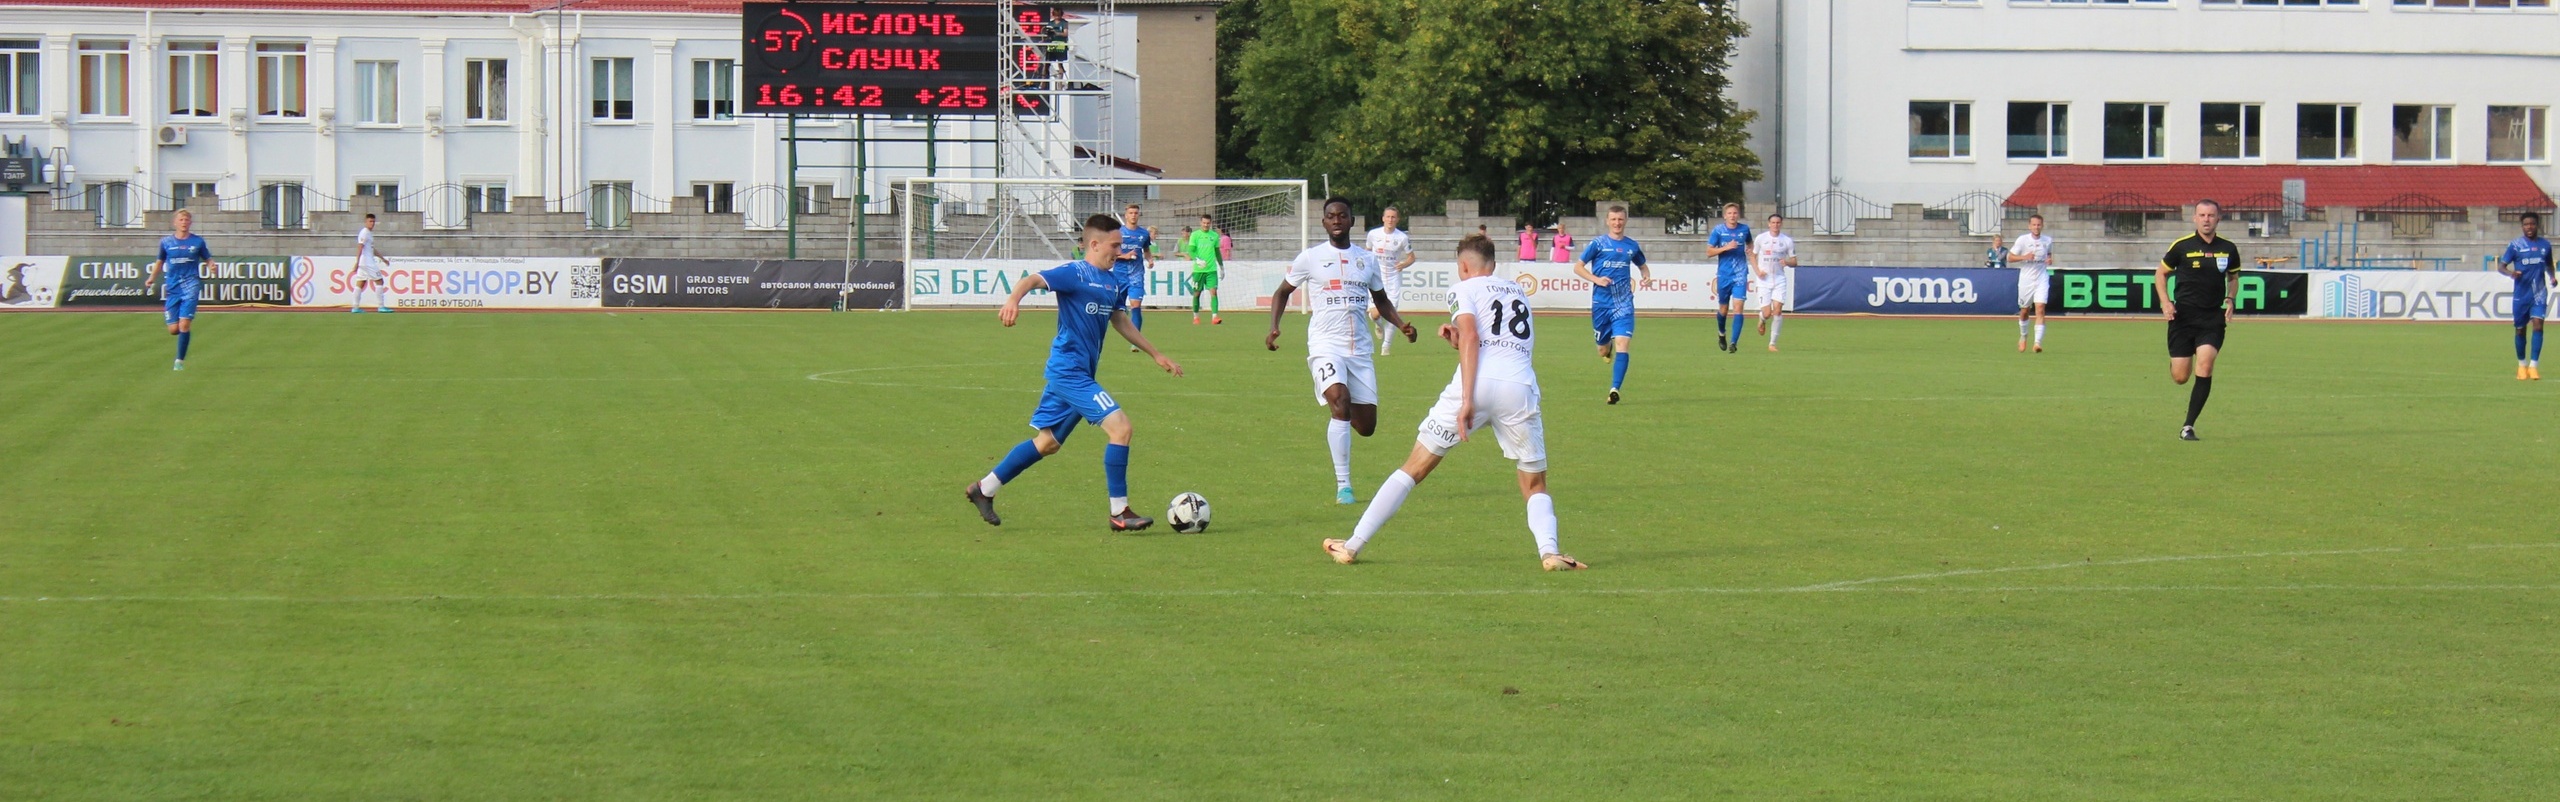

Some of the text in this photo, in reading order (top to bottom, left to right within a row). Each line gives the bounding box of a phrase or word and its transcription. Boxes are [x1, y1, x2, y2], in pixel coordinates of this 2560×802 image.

[821, 13, 965, 36] ИСЛОЧЬ
[765, 30, 803, 51] 57
[821, 48, 941, 70] СЛУЦК
[756, 84, 883, 107] 16:42
[79, 262, 139, 279] СТАНЬ
[686, 276, 750, 284] GRAD SEVEN
[219, 283, 285, 301] ИСЛОЧЬ
[613, 274, 667, 294] GSM
[686, 286, 729, 295] MOTORS
[760, 281, 896, 291] автосалон электромобилей
[2063, 274, 2266, 310] BETA
[398, 299, 484, 308] ВСЕ ДЛЯ ФУТБОЛА
[1490, 299, 1531, 340] 18
[1318, 362, 1337, 382] 23
[1093, 390, 1115, 411] 10
[1427, 418, 1456, 443] GSM
